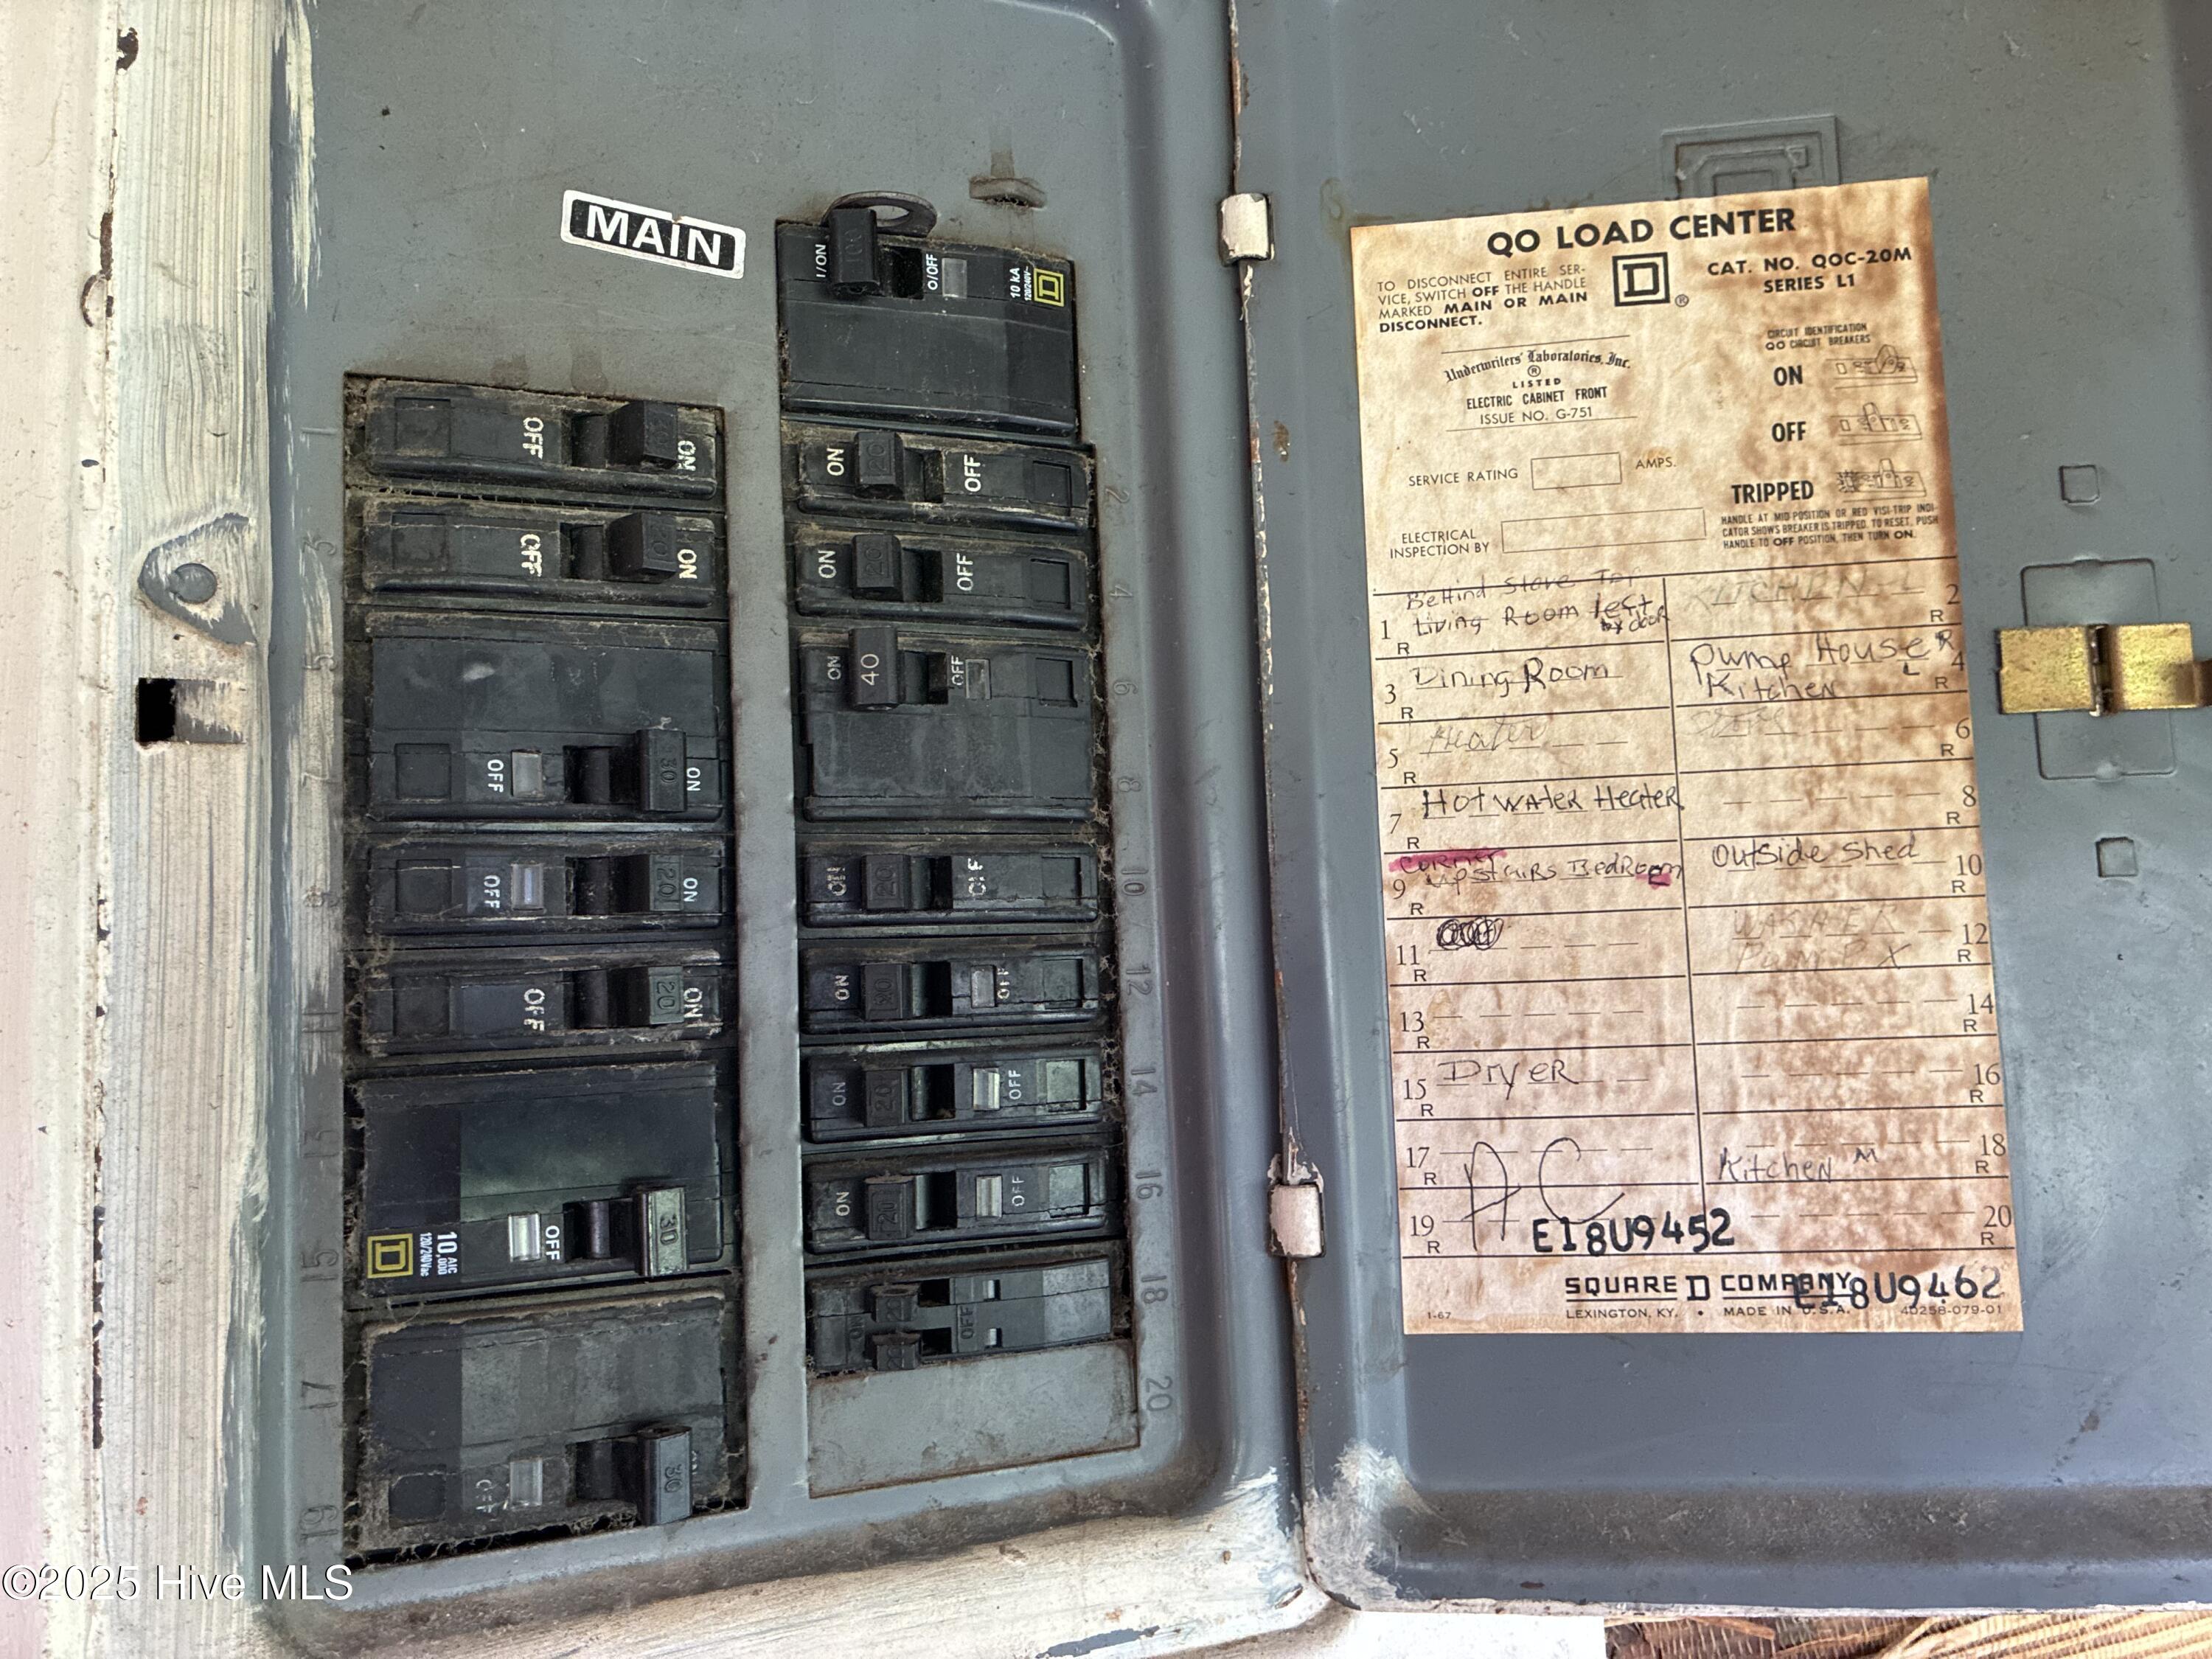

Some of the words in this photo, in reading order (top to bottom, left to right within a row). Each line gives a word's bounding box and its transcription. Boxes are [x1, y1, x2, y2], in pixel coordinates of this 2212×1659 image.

[587, 204, 721, 265] MAIN
[1487, 229, 1541, 258] QO
[1557, 219, 1654, 249] LOAD
[1669, 207, 1797, 240] CENTER
[1707, 260, 1753, 276] CAT.
[1763, 256, 1800, 272] NO.
[1811, 247, 1913, 270] QOC-20M
[1009, 267, 1020, 283] kA
[1377, 281, 1396, 292] TO
[1407, 271, 1492, 290] DISCONNECT
[1504, 267, 1548, 281] ENTIRE
[1559, 263, 1586, 275] SER-
[1763, 275, 1825, 293] SERIES
[1836, 273, 1856, 288] L1
[1010, 285, 1021, 298] 10
[1377, 293, 1411, 307] VICE,
[1415, 288, 1467, 303] SWITCH
[1472, 285, 1500, 296] OFF
[1504, 283, 1528, 295] THE
[1533, 277, 1586, 292] HANDLE
[1379, 305, 1433, 319] MARKED
[1444, 300, 1492, 314] MAIN
[1503, 297, 1528, 308] OR
[1538, 291, 1588, 306] MAIN
[1380, 315, 1483, 333] DISCONNECT.
[1767, 327, 1799, 339] CIRCUIT
[1804, 322, 1868, 336] IDENTIFICATION
[1764, 341, 1786, 350] QO
[1790, 338, 1821, 349] CIRCUIT
[1828, 334, 1871, 347] BREAKERS
[1512, 378, 1562, 389] LISTED
[1773, 365, 1804, 387] ON
[1467, 395, 1512, 411] ELECTRIC
[1522, 390, 1565, 406] CABINET
[1575, 386, 1608, 401] FRONT
[1480, 411, 1515, 425] ISSUE
[1522, 410, 1548, 422] NO.
[1556, 406, 1593, 420] G-751
[522, 417, 544, 460] OFF
[1771, 421, 1806, 442] OFF
[677, 440, 697, 472] ON
[827, 448, 846, 476] ON
[1635, 456, 1677, 470] AMPS.
[964, 454, 982, 493] OFF
[1408, 472, 1460, 487] SERVICE
[1467, 468, 1518, 482] RATING
[1731, 480, 1814, 504] TRIPPED
[1721, 514, 1753, 525] HANDLE
[1758, 514, 1768, 522] AT
[1835, 509, 1846, 518] OR
[1851, 507, 1868, 517] RED
[1722, 526, 1750, 538] CATOR
[1751, 524, 1781, 535] SHOWS
[1782, 522, 1819, 534] BREAKER
[1821, 522, 1830, 532] IS
[1871, 518, 1882, 529] TO
[1916, 515, 1939, 526] PUSH
[1402, 528, 1477, 544] ELECTRICAL
[1723, 539, 1755, 549] HANDLE
[1759, 538, 1769, 547] TO
[1773, 537, 1795, 546] OFF
[1843, 532, 1863, 542] THEN
[1868, 530, 1890, 541] TURN
[520, 534, 543, 577] OFF
[1390, 543, 1470, 560] INSPECTION
[1475, 541, 1490, 553] BY
[677, 549, 698, 580] ON
[817, 551, 838, 580] ON
[956, 553, 974, 591] OFF
[1947, 584, 1961, 605] 2
[1931, 609, 1944, 622] R
[1380, 620, 1391, 640] 1
[827, 655, 841, 681] ON
[860, 653, 880, 686] 40
[950, 655, 964, 686] OFF
[1951, 652, 1965, 672] 4
[1385, 684, 1397, 704] 3
[1955, 718, 1969, 739] 6
[1387, 747, 1399, 768] 5
[1941, 744, 1954, 756] R
[487, 759, 504, 793] OFF
[686, 767, 701, 791] ON
[1962, 785, 1976, 807] 8
[1388, 814, 1401, 834] 7
[1956, 855, 1983, 876] 10
[484, 874, 501, 908] OFF
[683, 877, 698, 902] ON
[1393, 879, 1406, 899] 9
[1952, 880, 1966, 893] R
[1962, 923, 1989, 946] 12
[1397, 945, 1420, 965] 11
[656, 981, 675, 1009] 20
[835, 975, 850, 1001] ON
[523, 988, 546, 1032] OFF
[683, 987, 703, 1019] ON
[1968, 993, 1994, 1015] 14
[1401, 1011, 1425, 1032] 13
[1963, 1019, 1977, 1032] R
[1008, 1069, 1021, 1100] OFF
[1974, 1062, 2001, 1085] 16
[832, 1081, 846, 1106] ON
[1403, 1078, 1427, 1099] 15
[1981, 1133, 2007, 1157] 18
[1407, 1147, 1430, 1168] 17
[1975, 1161, 1989, 1173] R
[1012, 1175, 1025, 1207] OFF
[836, 1191, 850, 1217] ON
[1410, 1214, 1434, 1237] 19
[1983, 1205, 2012, 1228] 20
[659, 1214, 678, 1245] 30
[545, 1225, 561, 1261] OFF
[1565, 1275, 1677, 1295] SQUARE
[1686, 1274, 1710, 1301] D
[960, 1306, 974, 1340] OFF
[1427, 1311, 1453, 1320] 1-67
[1566, 1308, 1652, 1320] LEXINGTON,
[1657, 1307, 1679, 1318] KY.
[1723, 1307, 1765, 1317] MADE
[1776, 1305, 1792, 1316] IN
